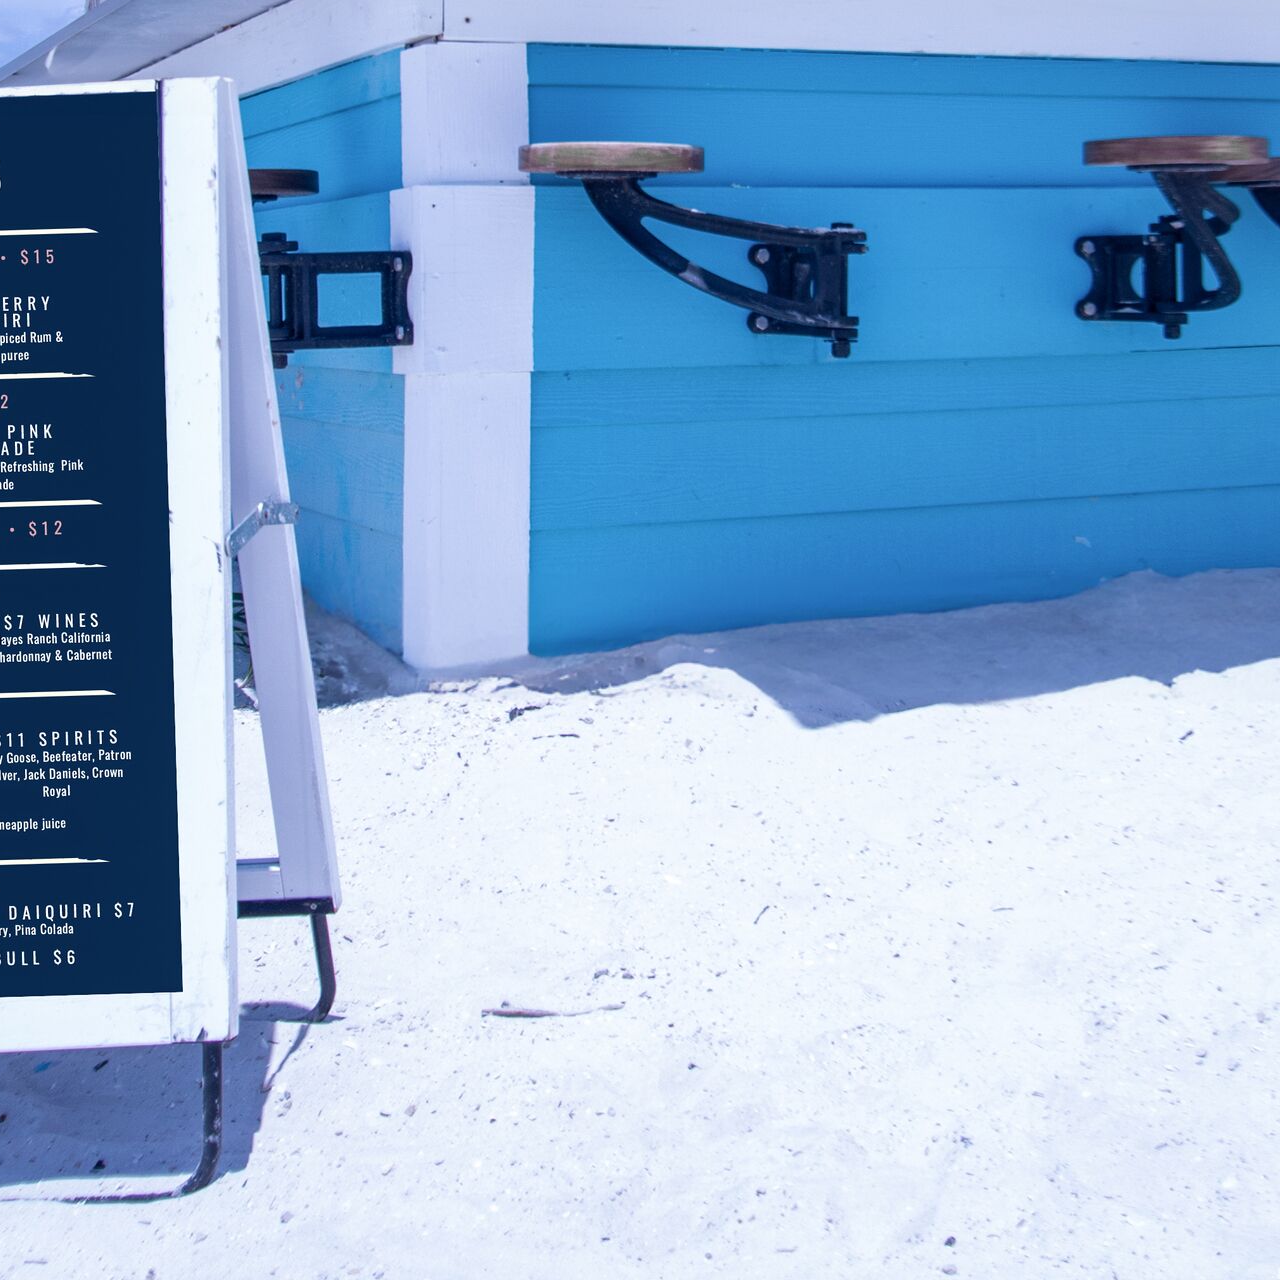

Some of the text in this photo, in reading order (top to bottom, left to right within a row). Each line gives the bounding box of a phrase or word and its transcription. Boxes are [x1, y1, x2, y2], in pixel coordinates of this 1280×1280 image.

[20, 248, 54, 266] $15
[29, 331, 52, 344] Rum
[55, 330, 64, 343] &
[0, 351, 30, 364] puree
[7, 423, 53, 440] PINK
[0, 460, 55, 474] Refreshing
[61, 458, 84, 472] Pink
[28, 520, 63, 537] $12
[3, 612, 99, 632] $7 WINES
[26, 632, 58, 645] Ranch
[60, 631, 111, 644] California
[54, 649, 63, 662] &
[66, 648, 113, 662] Cabernet
[38, 729, 118, 747] SPIRITS
[6, 751, 40, 765] Goose,
[42, 750, 95, 763] Beefeater,
[98, 748, 132, 761] Patron
[23, 767, 46, 781] Jack
[48, 767, 90, 780] Daniels,
[91, 766, 124, 779] Crown
[42, 784, 71, 799] Royal
[8, 902, 101, 922] DAIQUIRI
[114, 902, 134, 919] $7
[14, 924, 37, 937] Pina
[39, 922, 74, 935] Colada
[53, 948, 76, 966] $6
